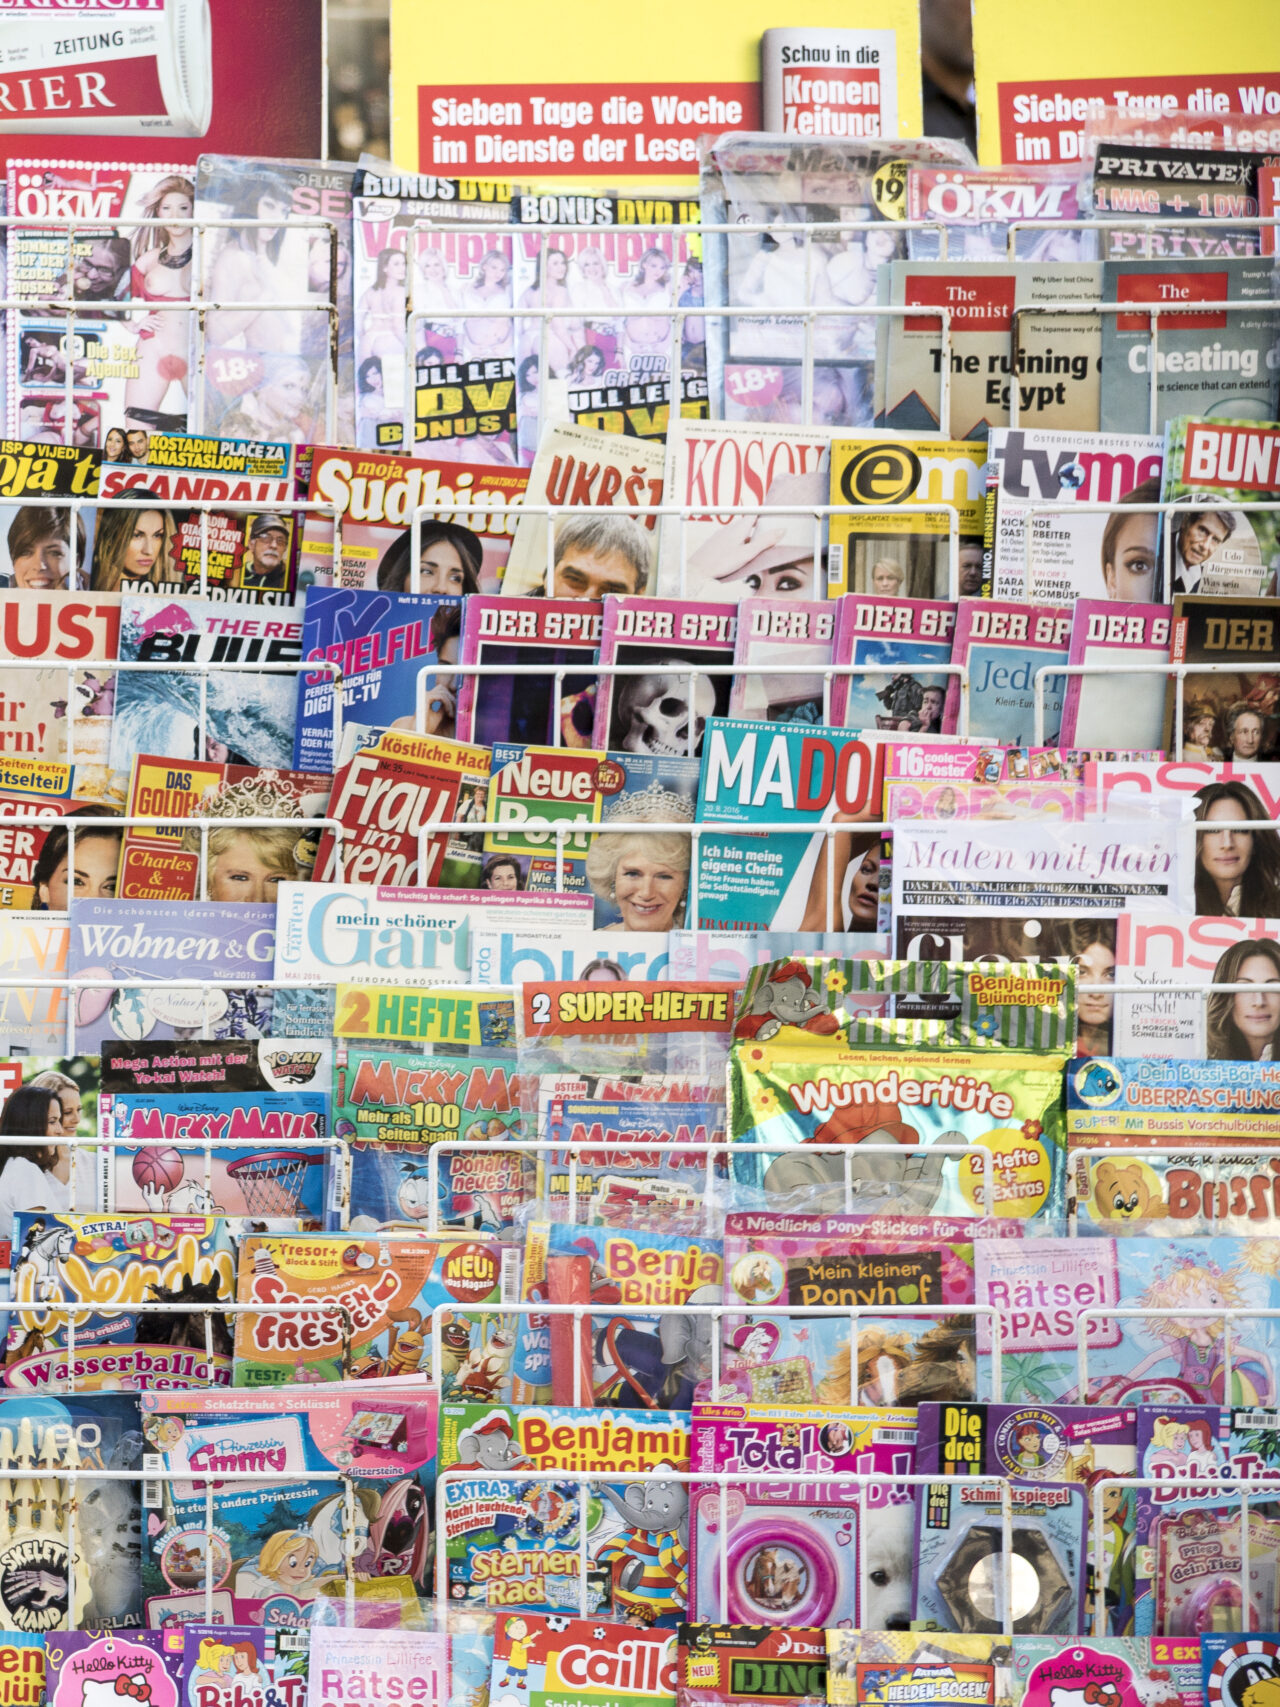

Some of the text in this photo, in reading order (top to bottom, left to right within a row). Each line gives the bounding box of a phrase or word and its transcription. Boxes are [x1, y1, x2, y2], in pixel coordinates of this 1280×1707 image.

[54, 30, 124, 56] ZEITUNG
[781, 45, 879, 64] Schau in die
[784, 76, 879, 105] Kronen
[432, 96, 742, 127] Sieben Tage die Woche
[433, 136, 627, 164] im Dienste der
[1099, 157, 1238, 184] PRIVATE
[20, 174, 120, 219] ÖKM
[928, 173, 1071, 219] ÖKM
[991, 348, 1088, 378] ruining
[986, 380, 1066, 410] Egypt
[149, 435, 218, 455] KOSTADIN
[357, 459, 404, 479] moja
[479, 608, 538, 637] DER
[855, 606, 912, 634] DER
[1204, 618, 1274, 650] DER
[34, 762, 68, 773] extra
[166, 771, 191, 790] DAS
[502, 762, 593, 799] Neue
[362, 828, 400, 849] im
[128, 852, 193, 873] Charles
[125, 882, 191, 900] Camilla
[336, 913, 456, 930] mein schöner
[79, 924, 220, 960] Wohnen
[969, 975, 1064, 992] Benjamin
[532, 992, 728, 1022] 2 SUPER-HEFTE
[979, 991, 1057, 1006] Blümchen
[340, 992, 473, 1038] 2 HEFTE
[111, 1052, 248, 1071] Mega Action mit der
[838, 1053, 971, 1065] Lesen, lachen, spielend lernen
[134, 1069, 225, 1085] Yo-kai Watch!
[791, 1072, 1013, 1117] Wundertüte
[413, 1103, 460, 1128] 100
[82, 1220, 127, 1237] EXTRA!
[747, 1220, 820, 1233] Niedliche
[808, 1263, 921, 1279] Mein kleiner
[988, 1279, 1106, 1308] Rätsel
[945, 1408, 981, 1436] Die
[945, 1435, 980, 1461] drei
[446, 1483, 509, 1500] EXTRA:
[72, 1656, 154, 1676] Hello Kitty
[692, 1664, 715, 1679] NEU!
[888, 1681, 990, 1702] HELDEN-BOGEN!
